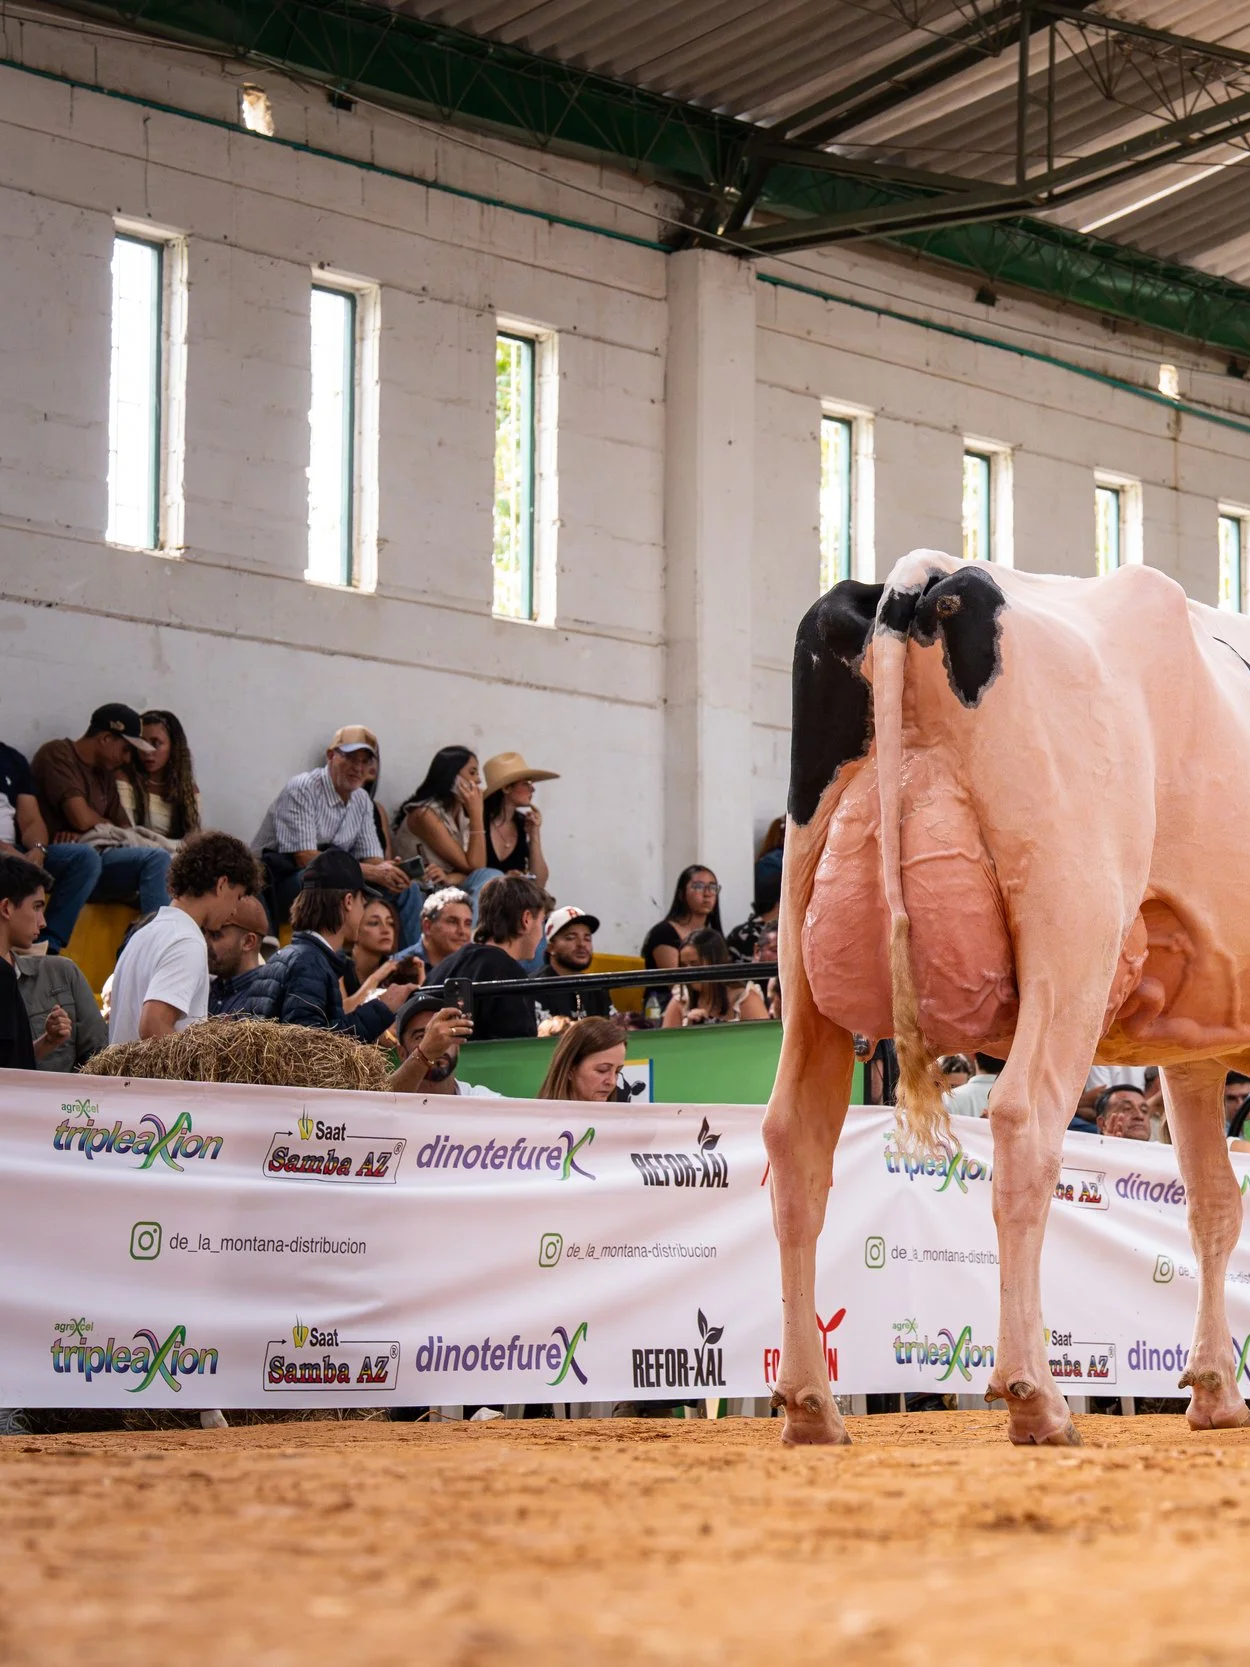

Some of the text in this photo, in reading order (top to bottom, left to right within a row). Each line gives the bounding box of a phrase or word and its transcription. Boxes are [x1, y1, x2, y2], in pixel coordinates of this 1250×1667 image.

[315, 1120, 346, 1142] Saat
[269, 1146, 392, 1178] Samba AZ
[630, 1153, 729, 1188] REFOR-XAL
[1115, 1172, 1187, 1205] dinote
[169, 1233, 367, 1255] de_la_montana-distribucion
[309, 1327, 339, 1347] Saat
[1051, 1330, 1072, 1346] Saat
[268, 1355, 389, 1384] Samba AZ
[633, 1348, 726, 1388] REFOR-XAL
[1049, 1353, 1109, 1377] mba AZ
